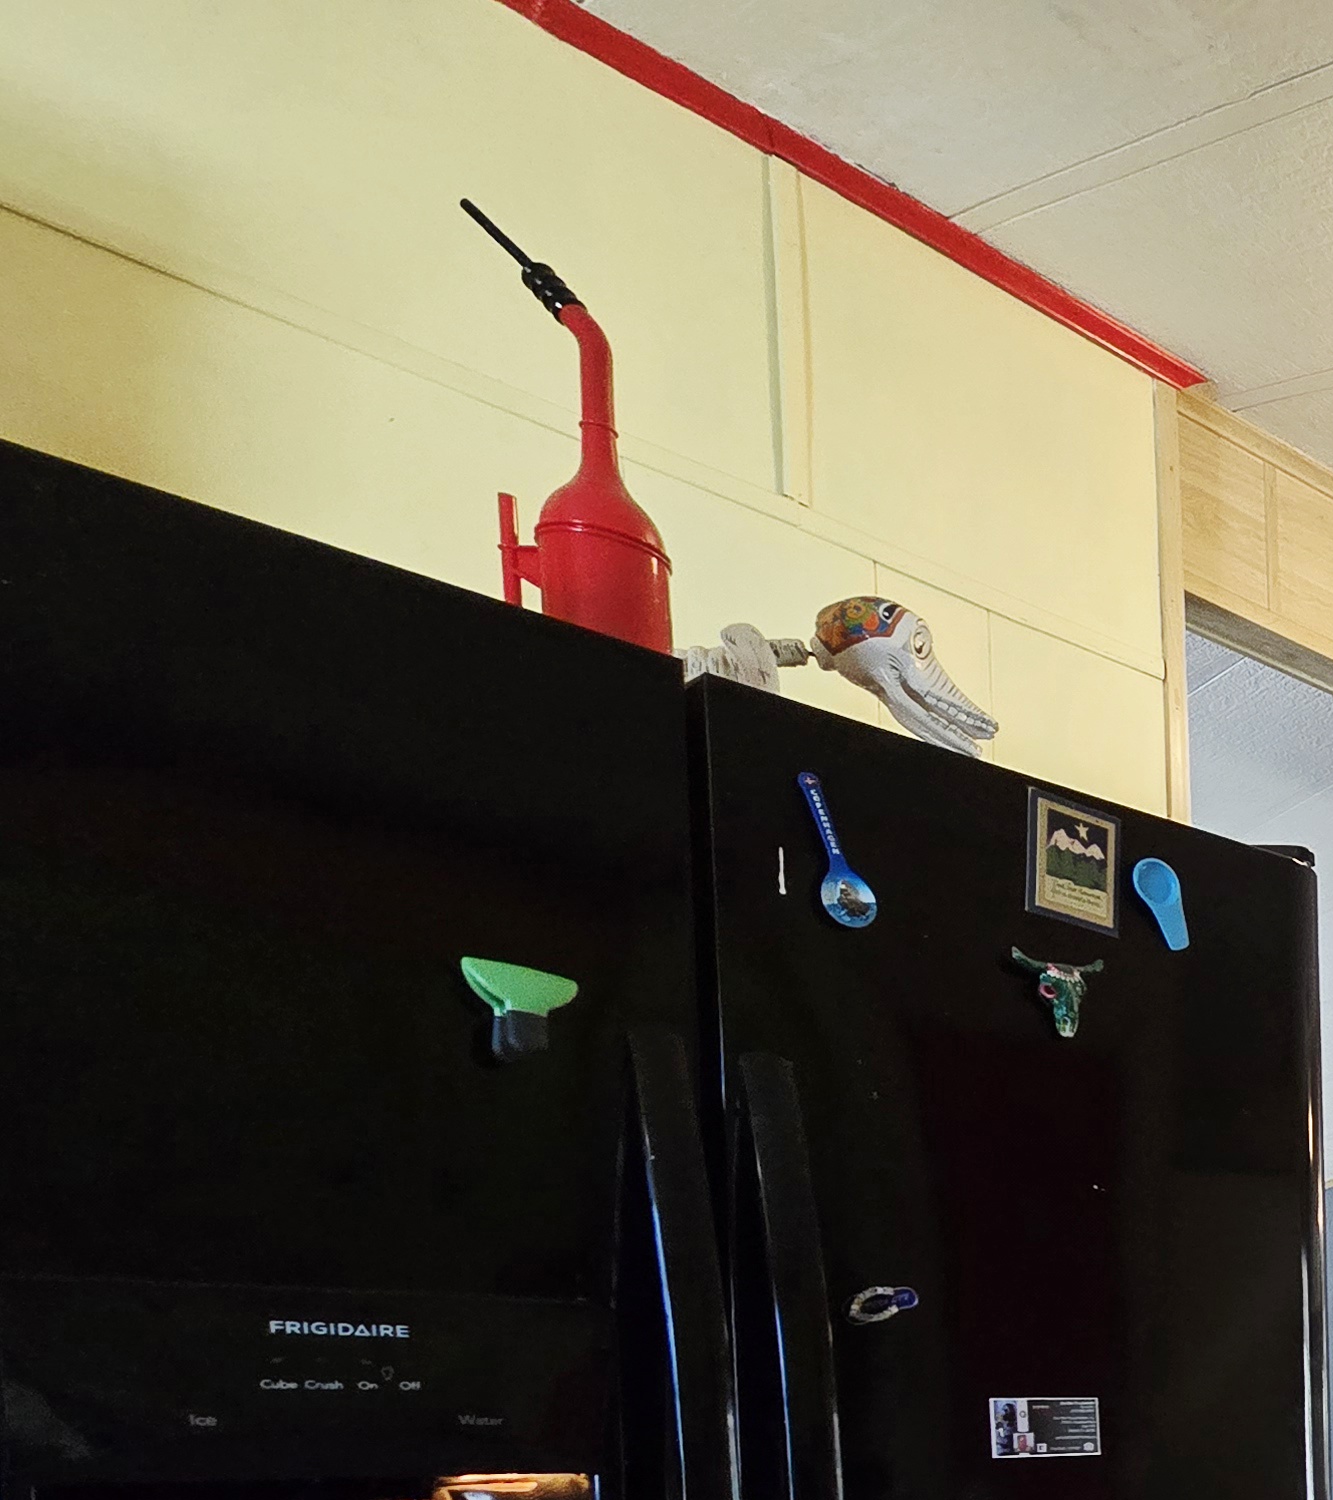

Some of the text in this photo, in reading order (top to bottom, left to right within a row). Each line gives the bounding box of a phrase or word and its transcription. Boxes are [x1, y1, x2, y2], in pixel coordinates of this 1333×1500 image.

[269, 1320, 411, 1339] FRIGIDAIRE
[259, 1379, 345, 1391] Cube Crush
[357, 1380, 422, 1391] On Off
[189, 1414, 218, 1427] Ice
[457, 1414, 505, 1427] Water
